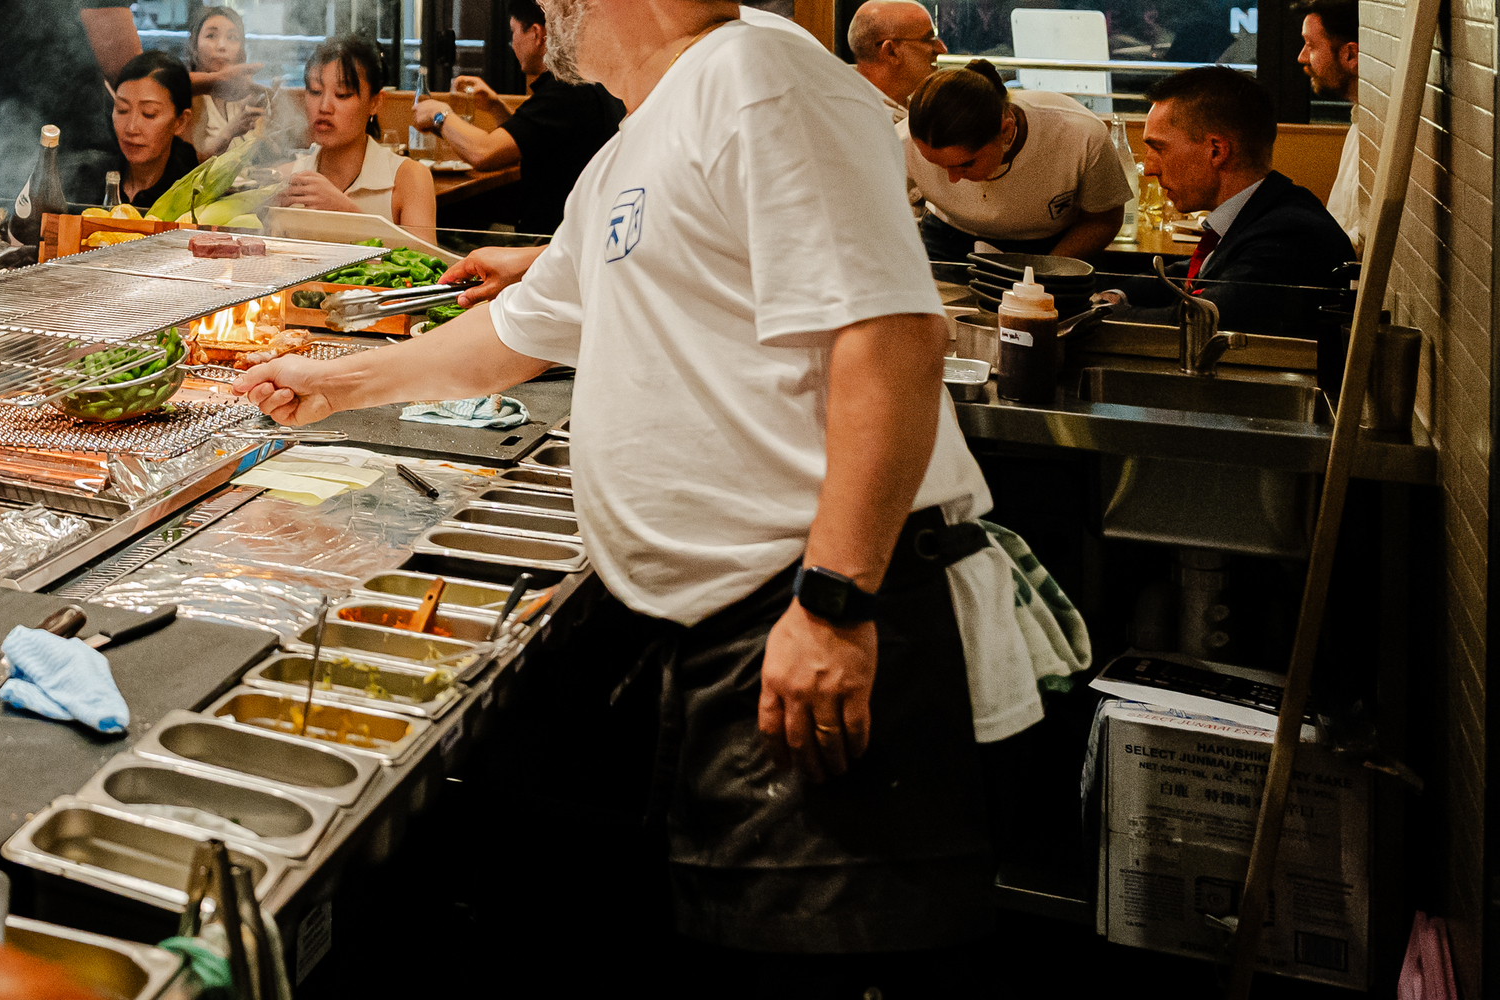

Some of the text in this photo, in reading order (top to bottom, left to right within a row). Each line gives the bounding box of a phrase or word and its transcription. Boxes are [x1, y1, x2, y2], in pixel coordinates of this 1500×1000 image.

[1125, 744, 1176, 760] SELECT
[1179, 753, 1231, 769] JUNMAI
[1233, 761, 1269, 774] EXTR
[1315, 774, 1353, 790] SAKE
